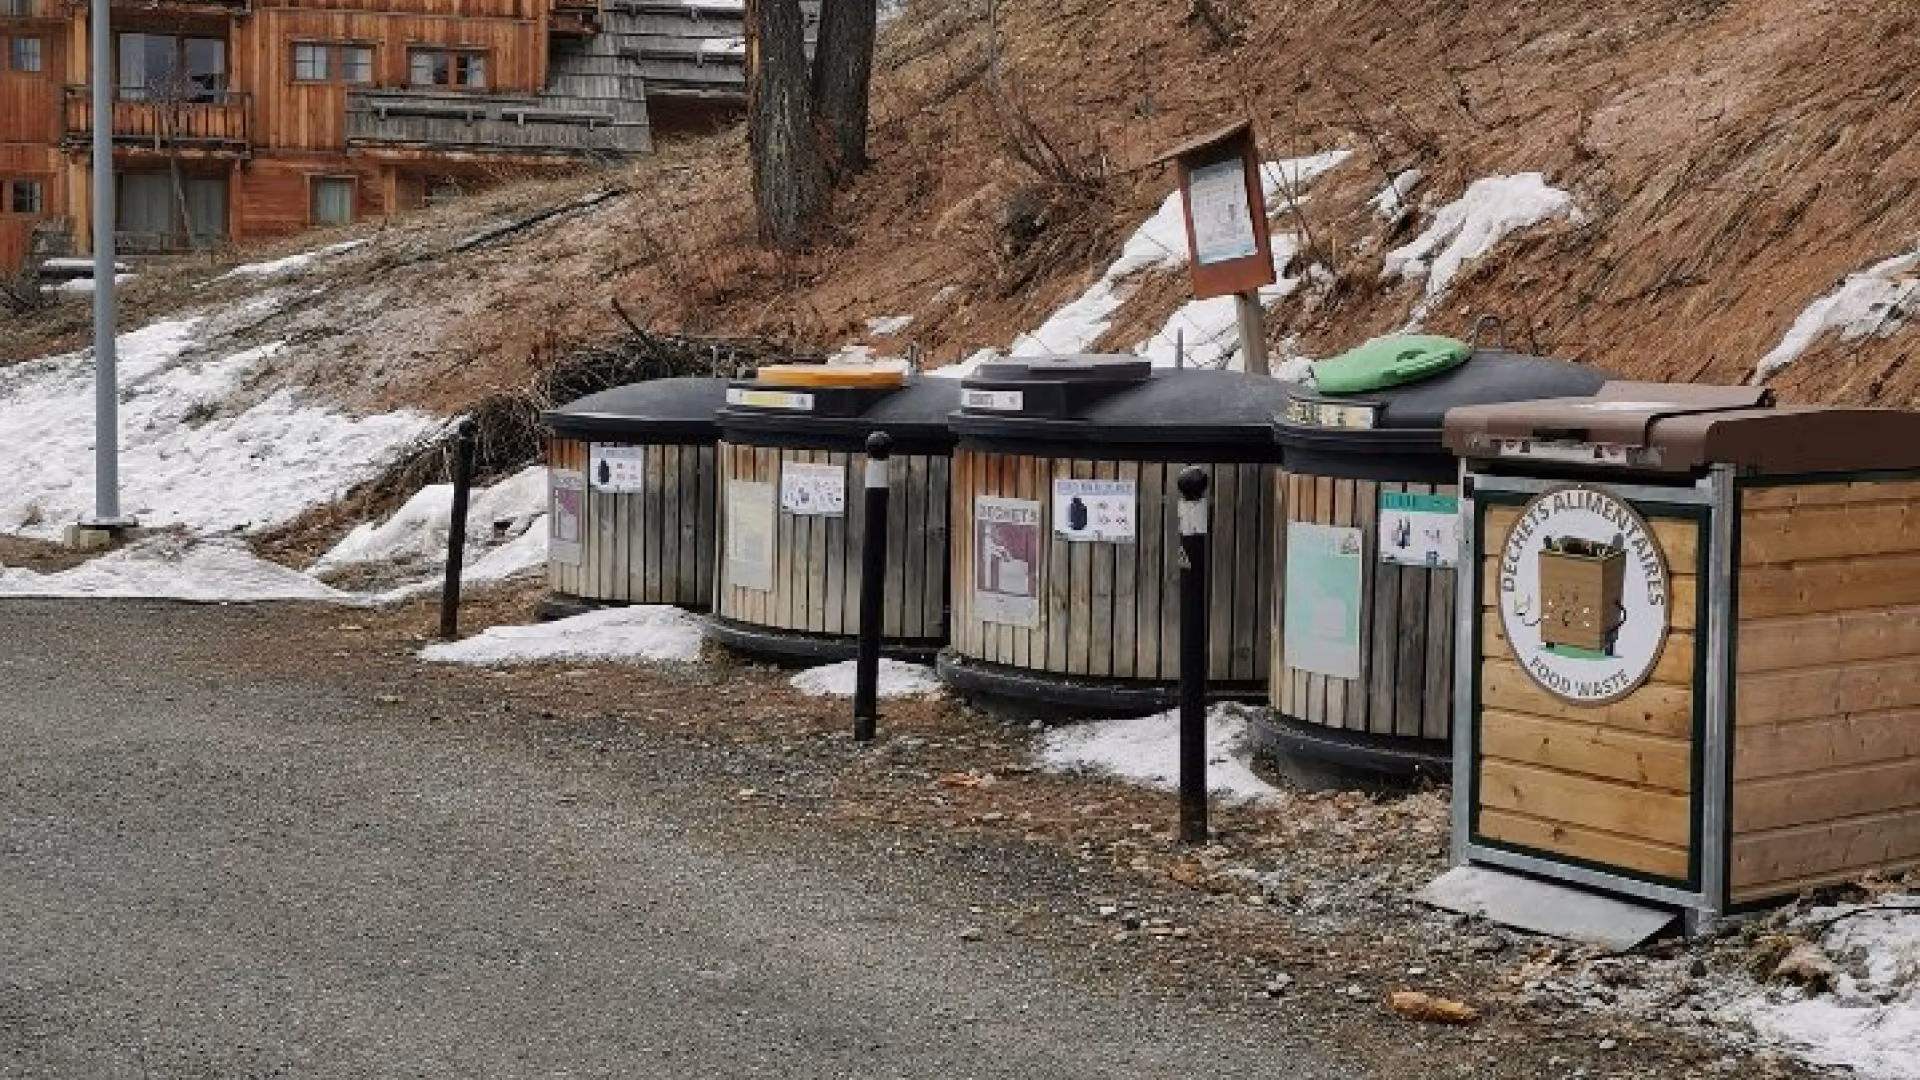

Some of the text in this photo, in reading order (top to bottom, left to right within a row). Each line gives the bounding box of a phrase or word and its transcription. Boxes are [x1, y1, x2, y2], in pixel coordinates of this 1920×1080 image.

[1554, 491, 1665, 606] ALIMENTAIRES
[1530, 655, 1630, 697] FOOD WASTE
